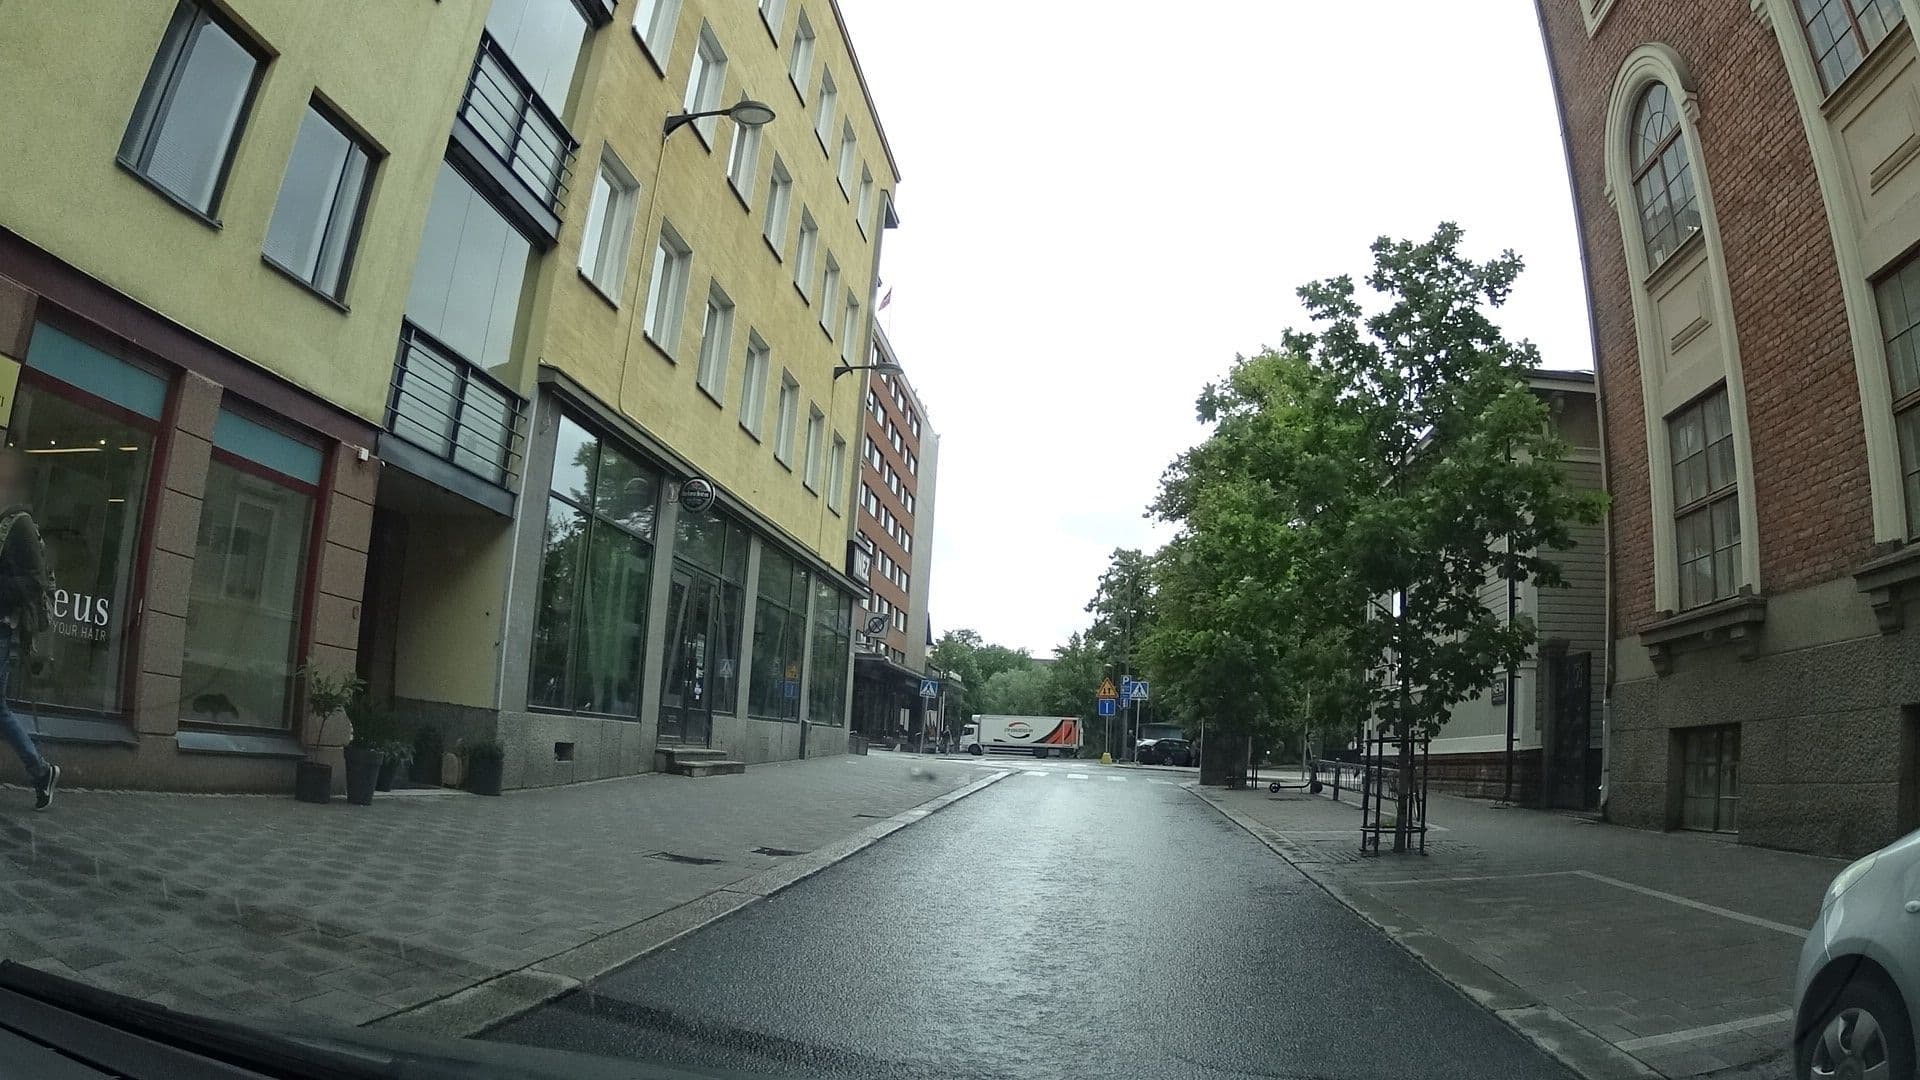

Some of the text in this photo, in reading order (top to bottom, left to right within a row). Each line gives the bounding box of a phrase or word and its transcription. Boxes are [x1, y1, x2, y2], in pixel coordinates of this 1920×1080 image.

[52, 620, 106, 642] YOUR HAIR
[1122, 675, 1129, 685] P
